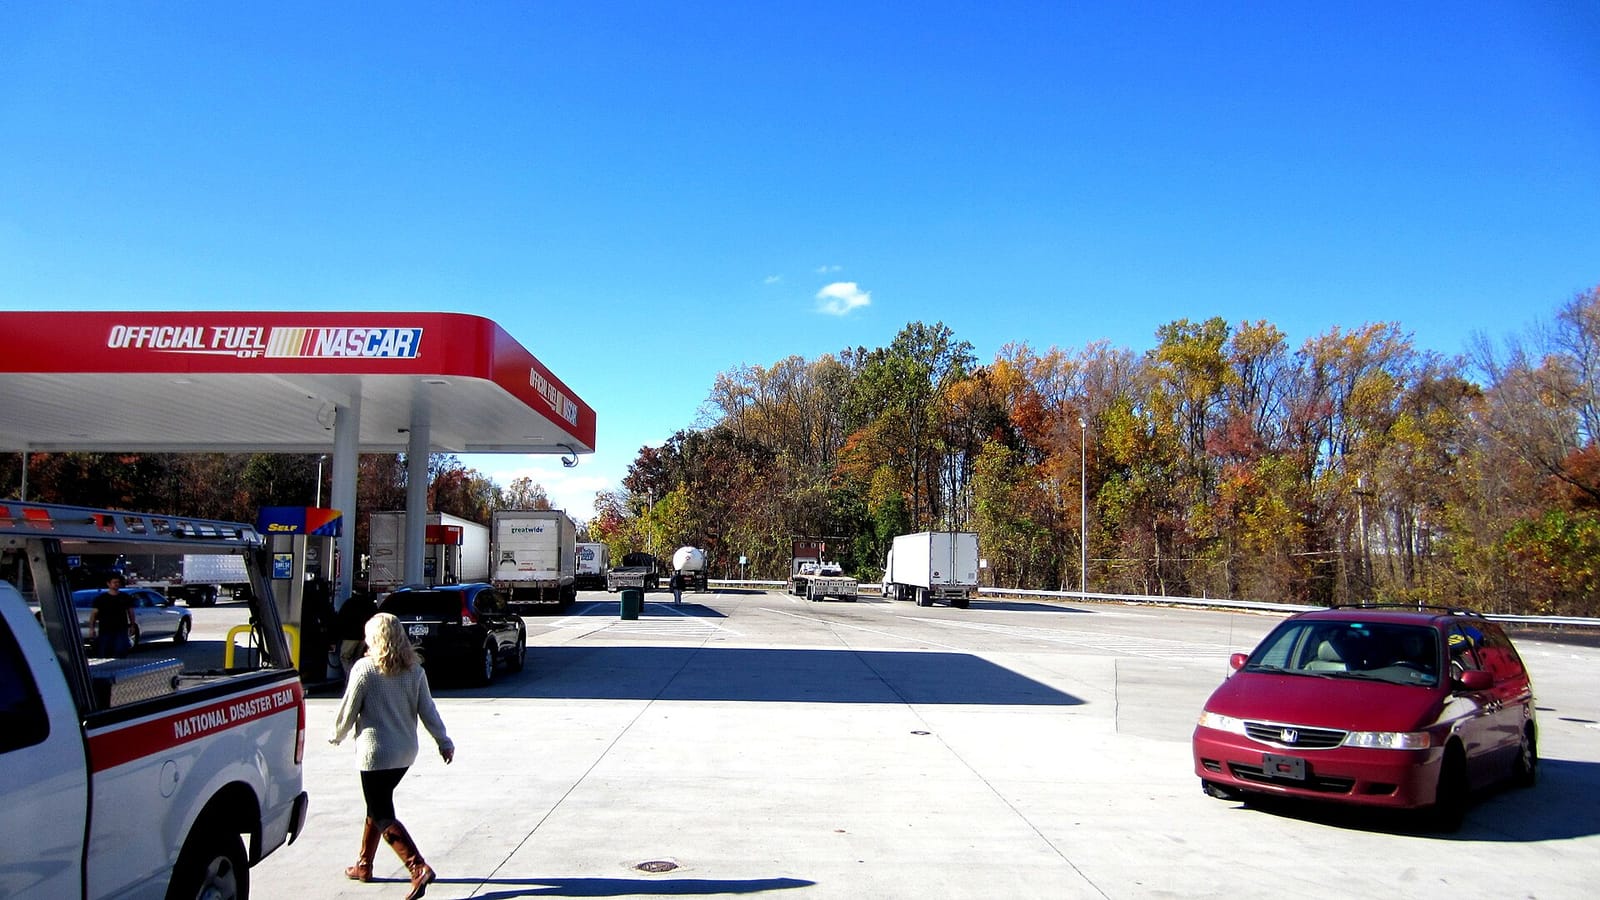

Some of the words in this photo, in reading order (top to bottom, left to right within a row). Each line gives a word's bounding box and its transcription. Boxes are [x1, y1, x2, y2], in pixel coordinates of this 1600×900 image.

[107, 325, 205, 348] OFFICIAL
[210, 326, 266, 349] FUEL
[313, 328, 414, 357] NASCAR
[237, 350, 264, 358] OF
[174, 708, 228, 739] NATIONAL
[230, 695, 272, 721] DISASTER
[272, 689, 294, 708] TEAM
